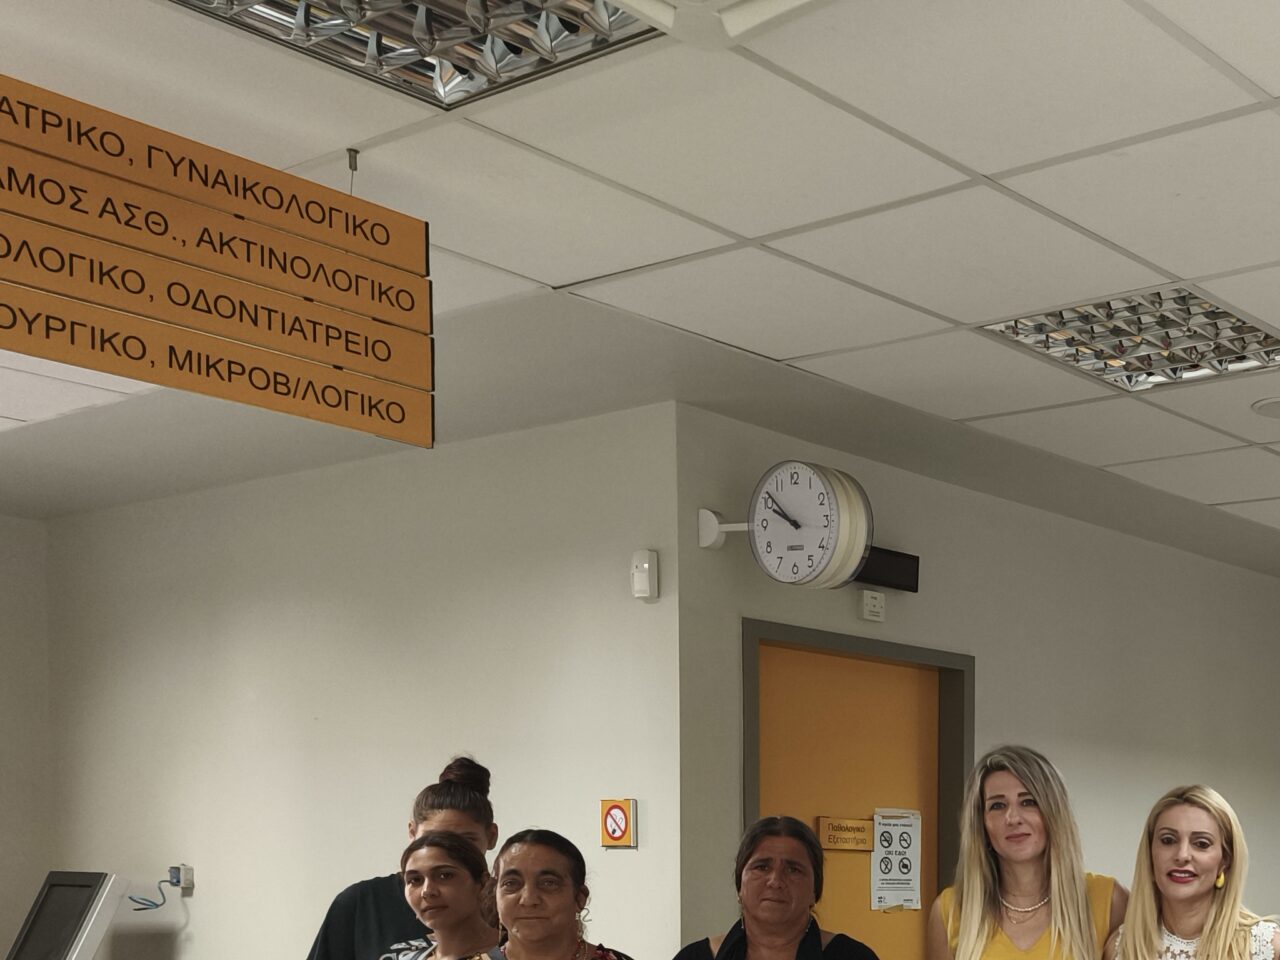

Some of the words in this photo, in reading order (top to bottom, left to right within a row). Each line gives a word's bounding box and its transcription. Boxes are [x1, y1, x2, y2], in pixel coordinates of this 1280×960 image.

[147, 144, 392, 248] ΓΥΝΑΙΚΟΛΟΓΙΚΟ
[0, 165, 89, 215] ΜΟΣ
[97, 196, 187, 248] ΑΣΘ.,
[196, 226, 416, 312] ΑΚΤΙΝΟΛΟΓΙΚΟ
[166, 281, 392, 363] ΟΔΟΝΤΙΑΤΡΕΙΟ
[168, 344, 407, 424] ΜΙΚΡΟΒ/ΛΟΓΙΚΟ
[775, 477, 783, 492] 11
[789, 471, 799, 485] 12
[761, 495, 774, 510] 10
[817, 492, 825, 506] 2
[761, 518, 768, 531] 9
[823, 514, 829, 528] 3
[765, 541, 772, 554] 8
[818, 537, 825, 551] 4
[775, 556, 783, 573] 7
[791, 561, 799, 575] 6
[807, 554, 814, 568] 5
